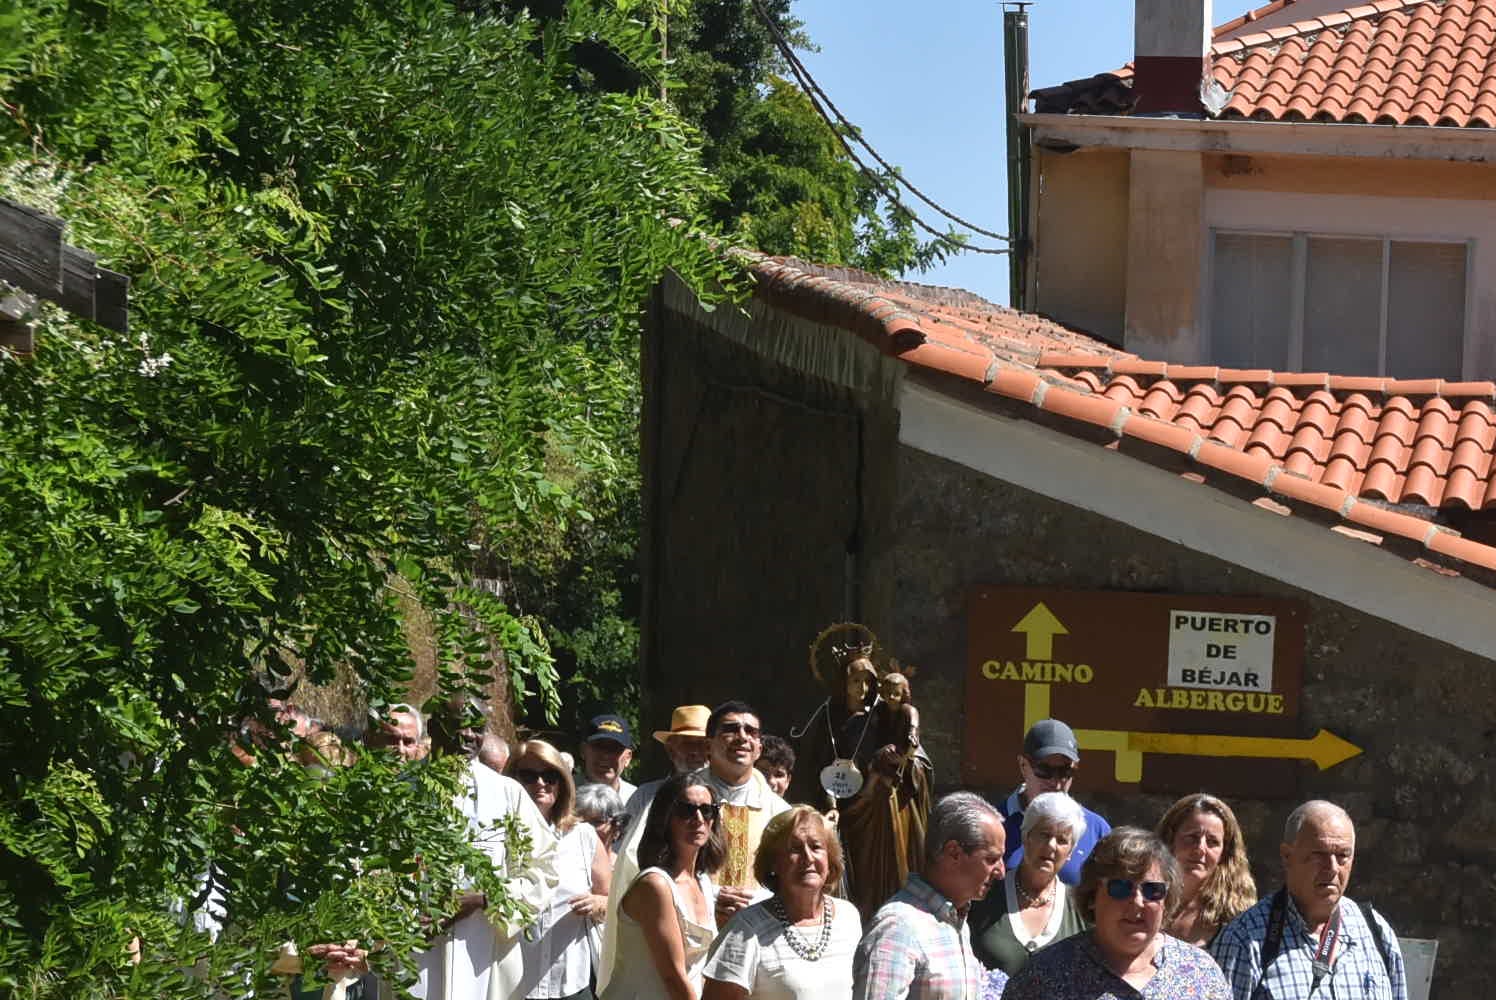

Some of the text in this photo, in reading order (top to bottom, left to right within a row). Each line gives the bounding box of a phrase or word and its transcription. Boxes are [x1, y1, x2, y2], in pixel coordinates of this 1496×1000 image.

[1175, 615, 1271, 635] PUERTO
[1206, 643, 1237, 660] DE
[982, 660, 1094, 684] CAMINO
[1182, 666, 1260, 688] BÉJAR
[1133, 687, 1284, 714] ALBERGUE
